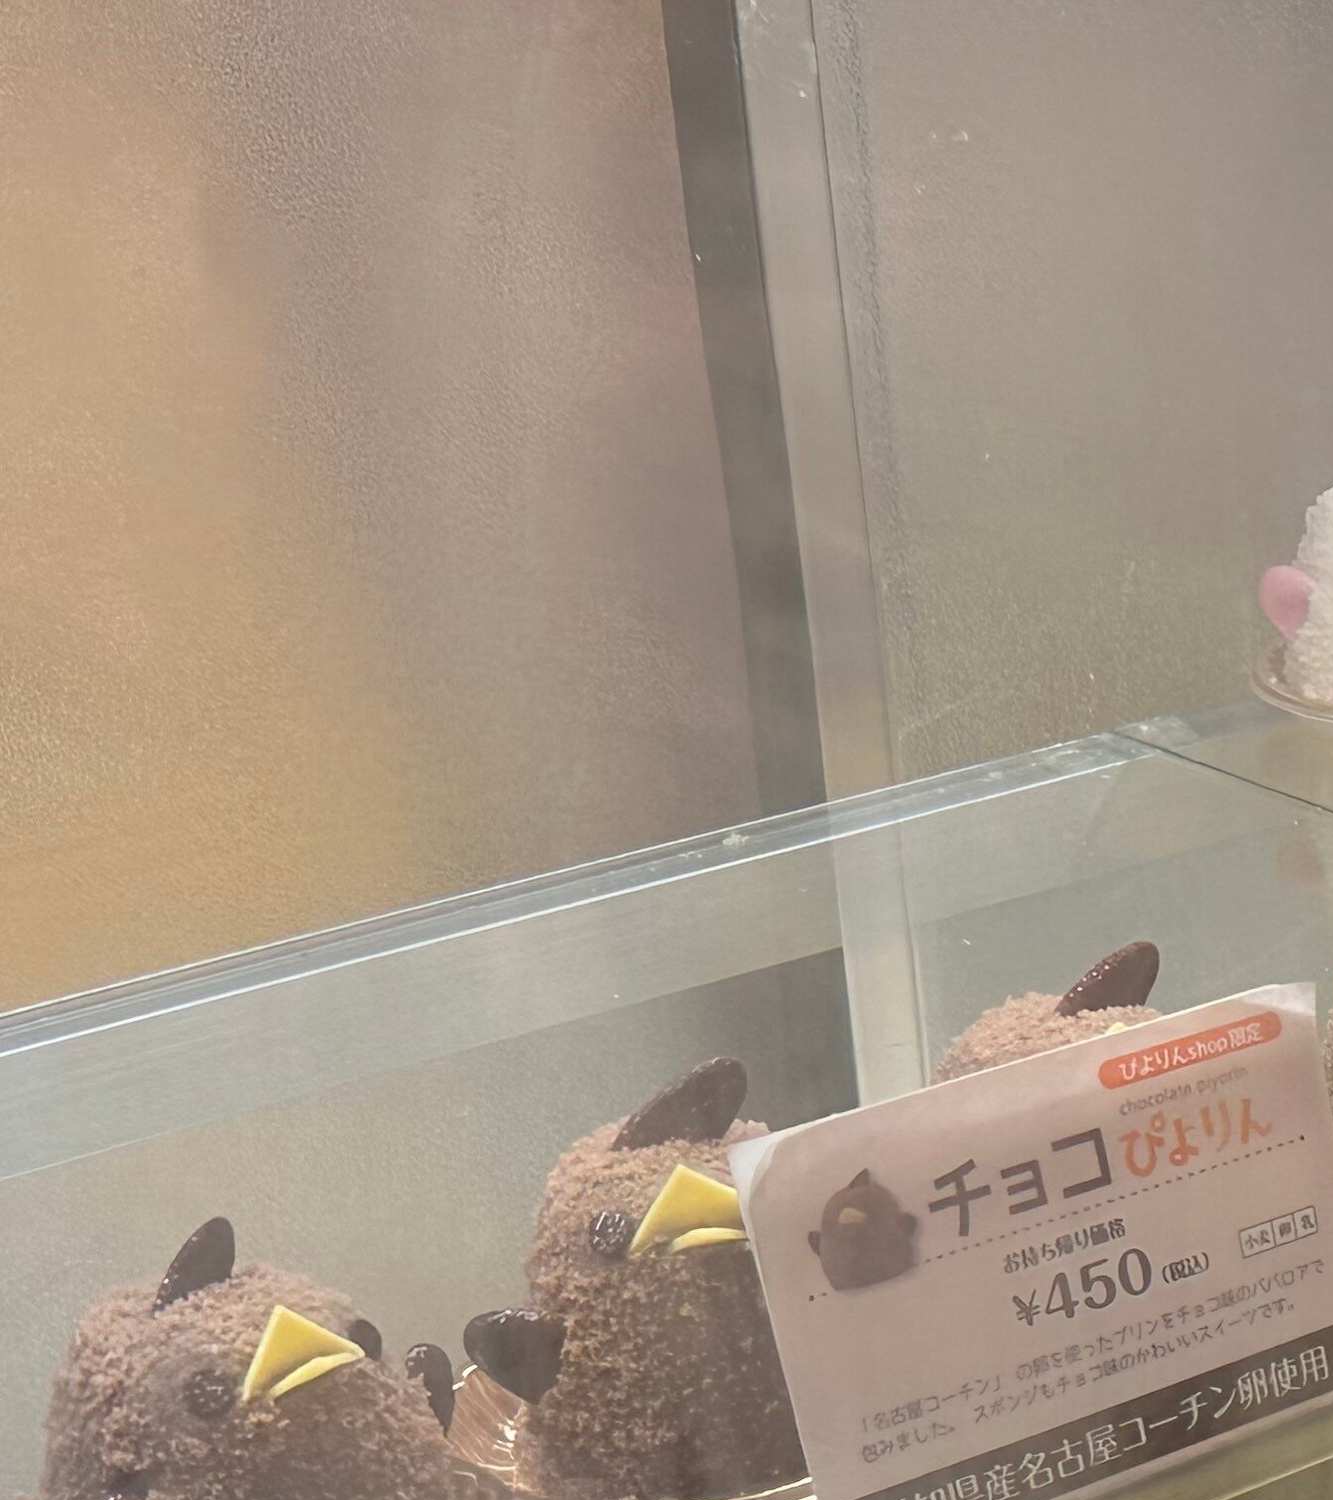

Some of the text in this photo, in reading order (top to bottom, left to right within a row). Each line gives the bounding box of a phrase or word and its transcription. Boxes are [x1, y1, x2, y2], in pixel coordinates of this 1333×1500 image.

[1003, 1218, 1126, 1274] お持ち帰り価格
[1012, 1248, 1152, 1326] ¥450
